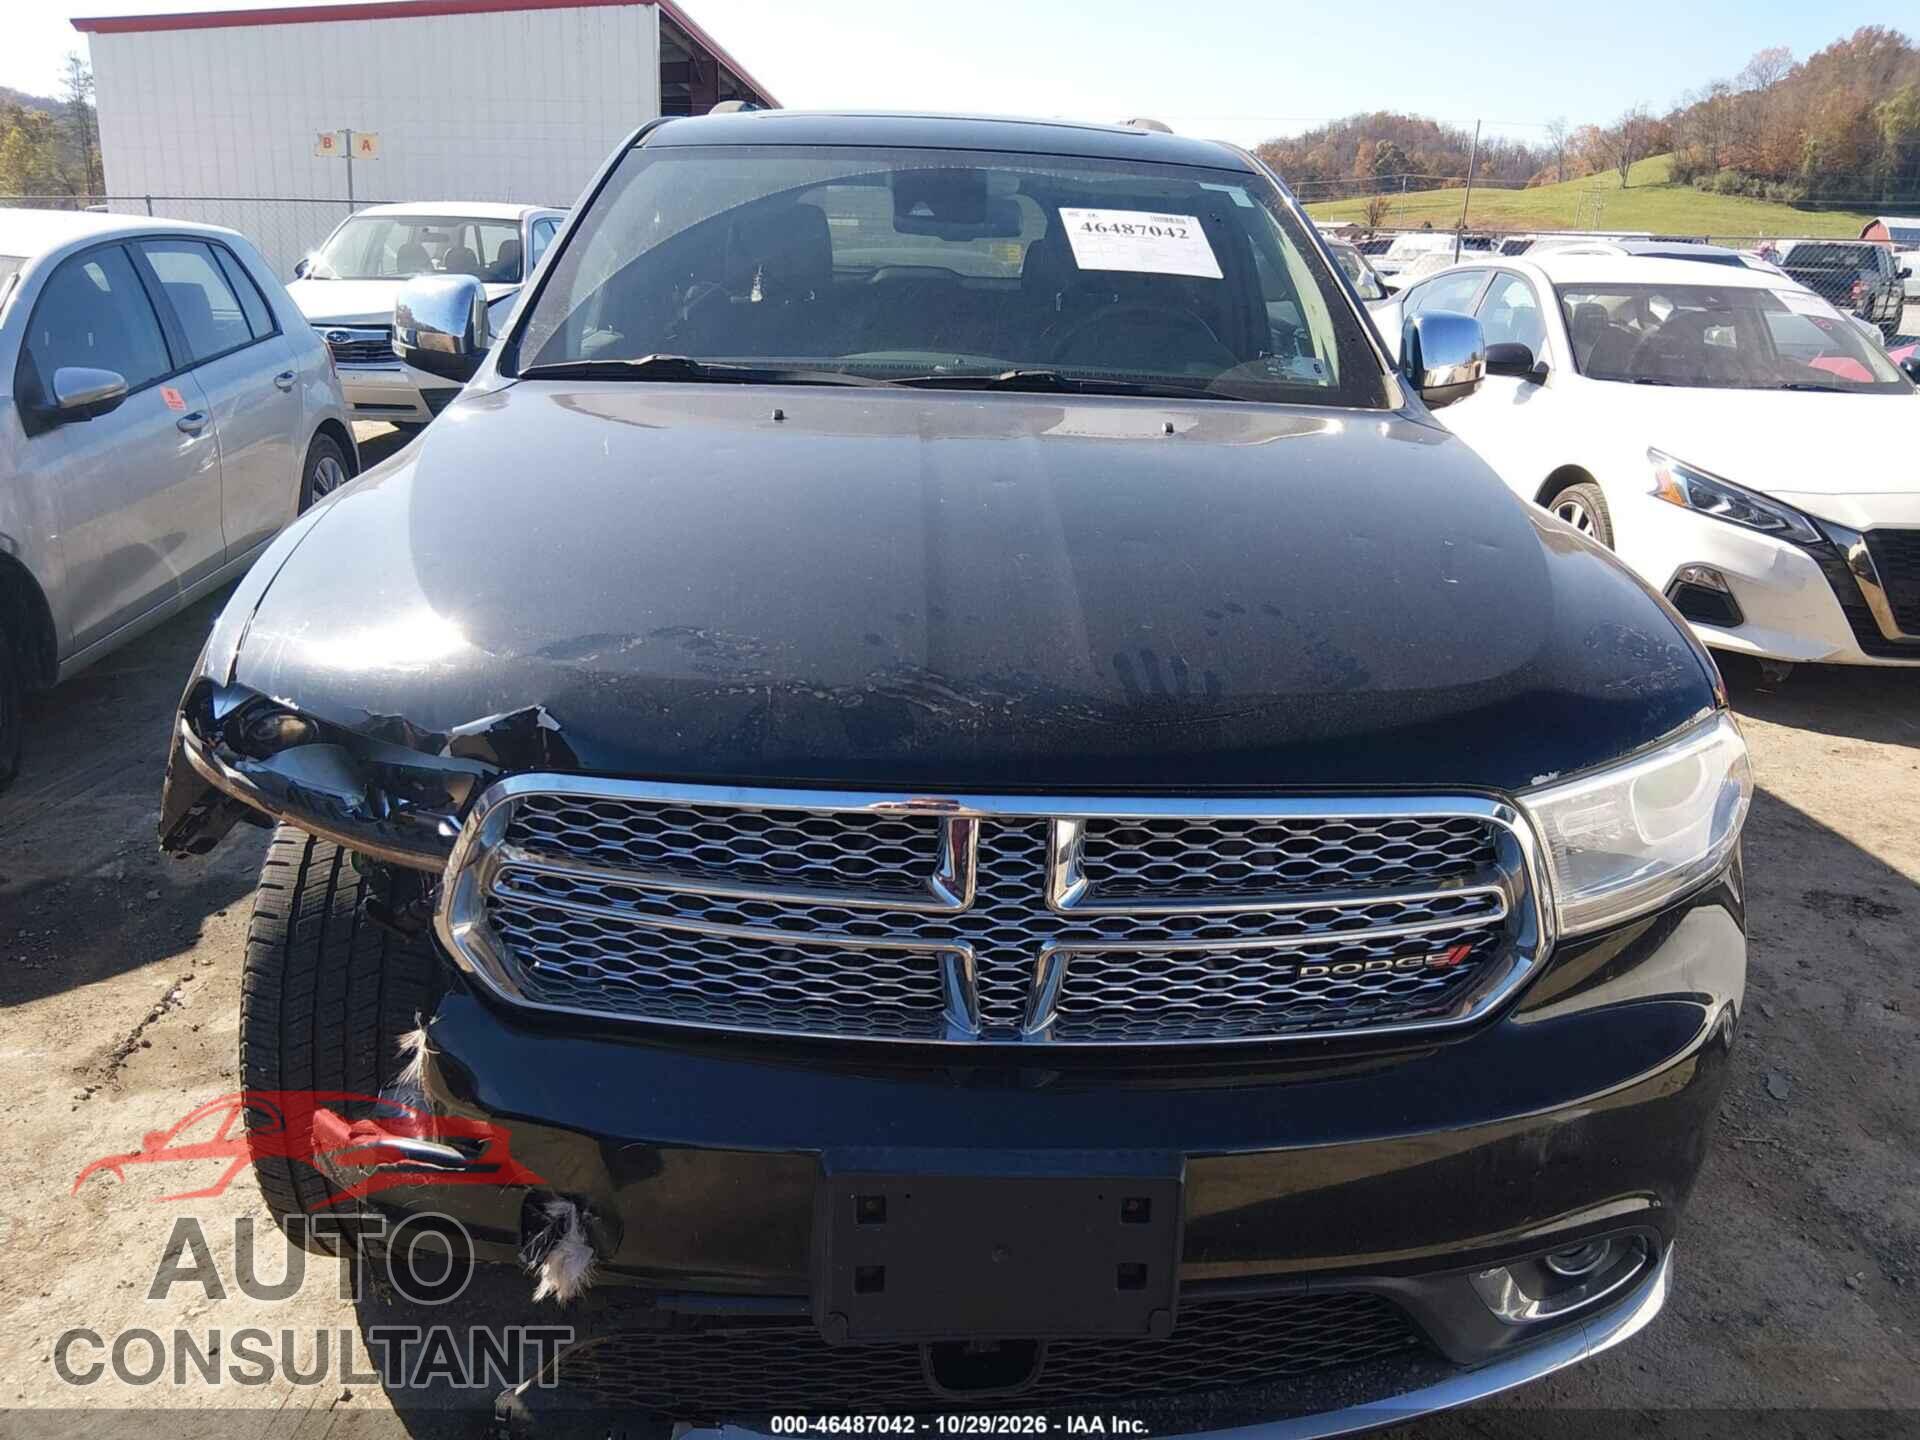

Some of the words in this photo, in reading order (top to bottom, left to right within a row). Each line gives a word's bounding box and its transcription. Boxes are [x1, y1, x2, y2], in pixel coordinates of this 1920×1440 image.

[323, 136, 333, 149] B
[361, 139, 372, 152] A
[1080, 221, 1190, 239] 46487042
[1300, 953, 1452, 977] DODGE
